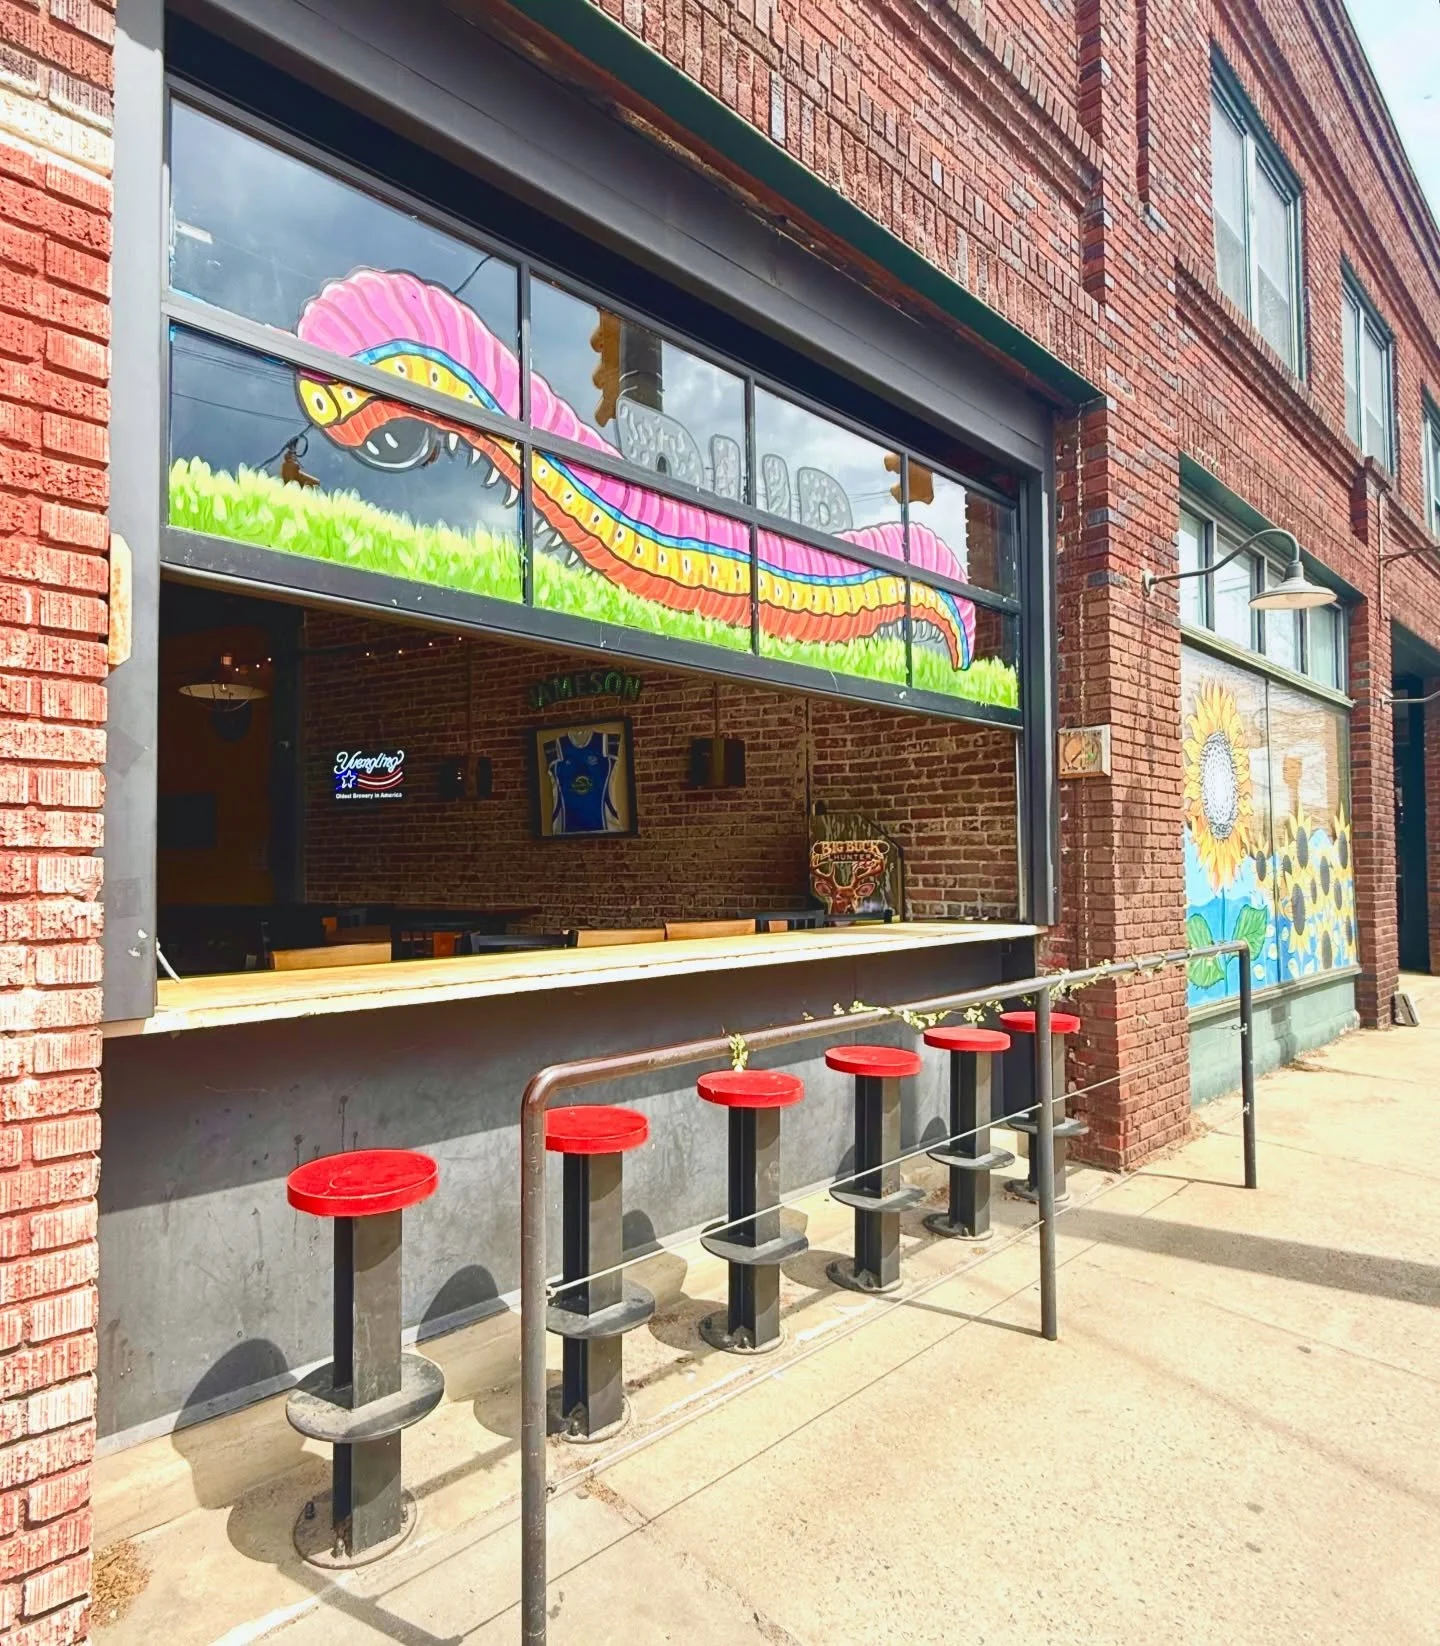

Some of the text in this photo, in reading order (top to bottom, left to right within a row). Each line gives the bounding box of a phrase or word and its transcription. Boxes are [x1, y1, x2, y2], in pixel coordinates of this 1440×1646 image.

[528, 670, 641, 710] JAMESON
[334, 750, 404, 774] Yuengling
[353, 792, 373, 800] Brewery
[822, 840, 883, 856] BIG BUCK
[833, 853, 872, 861] HUNTER
